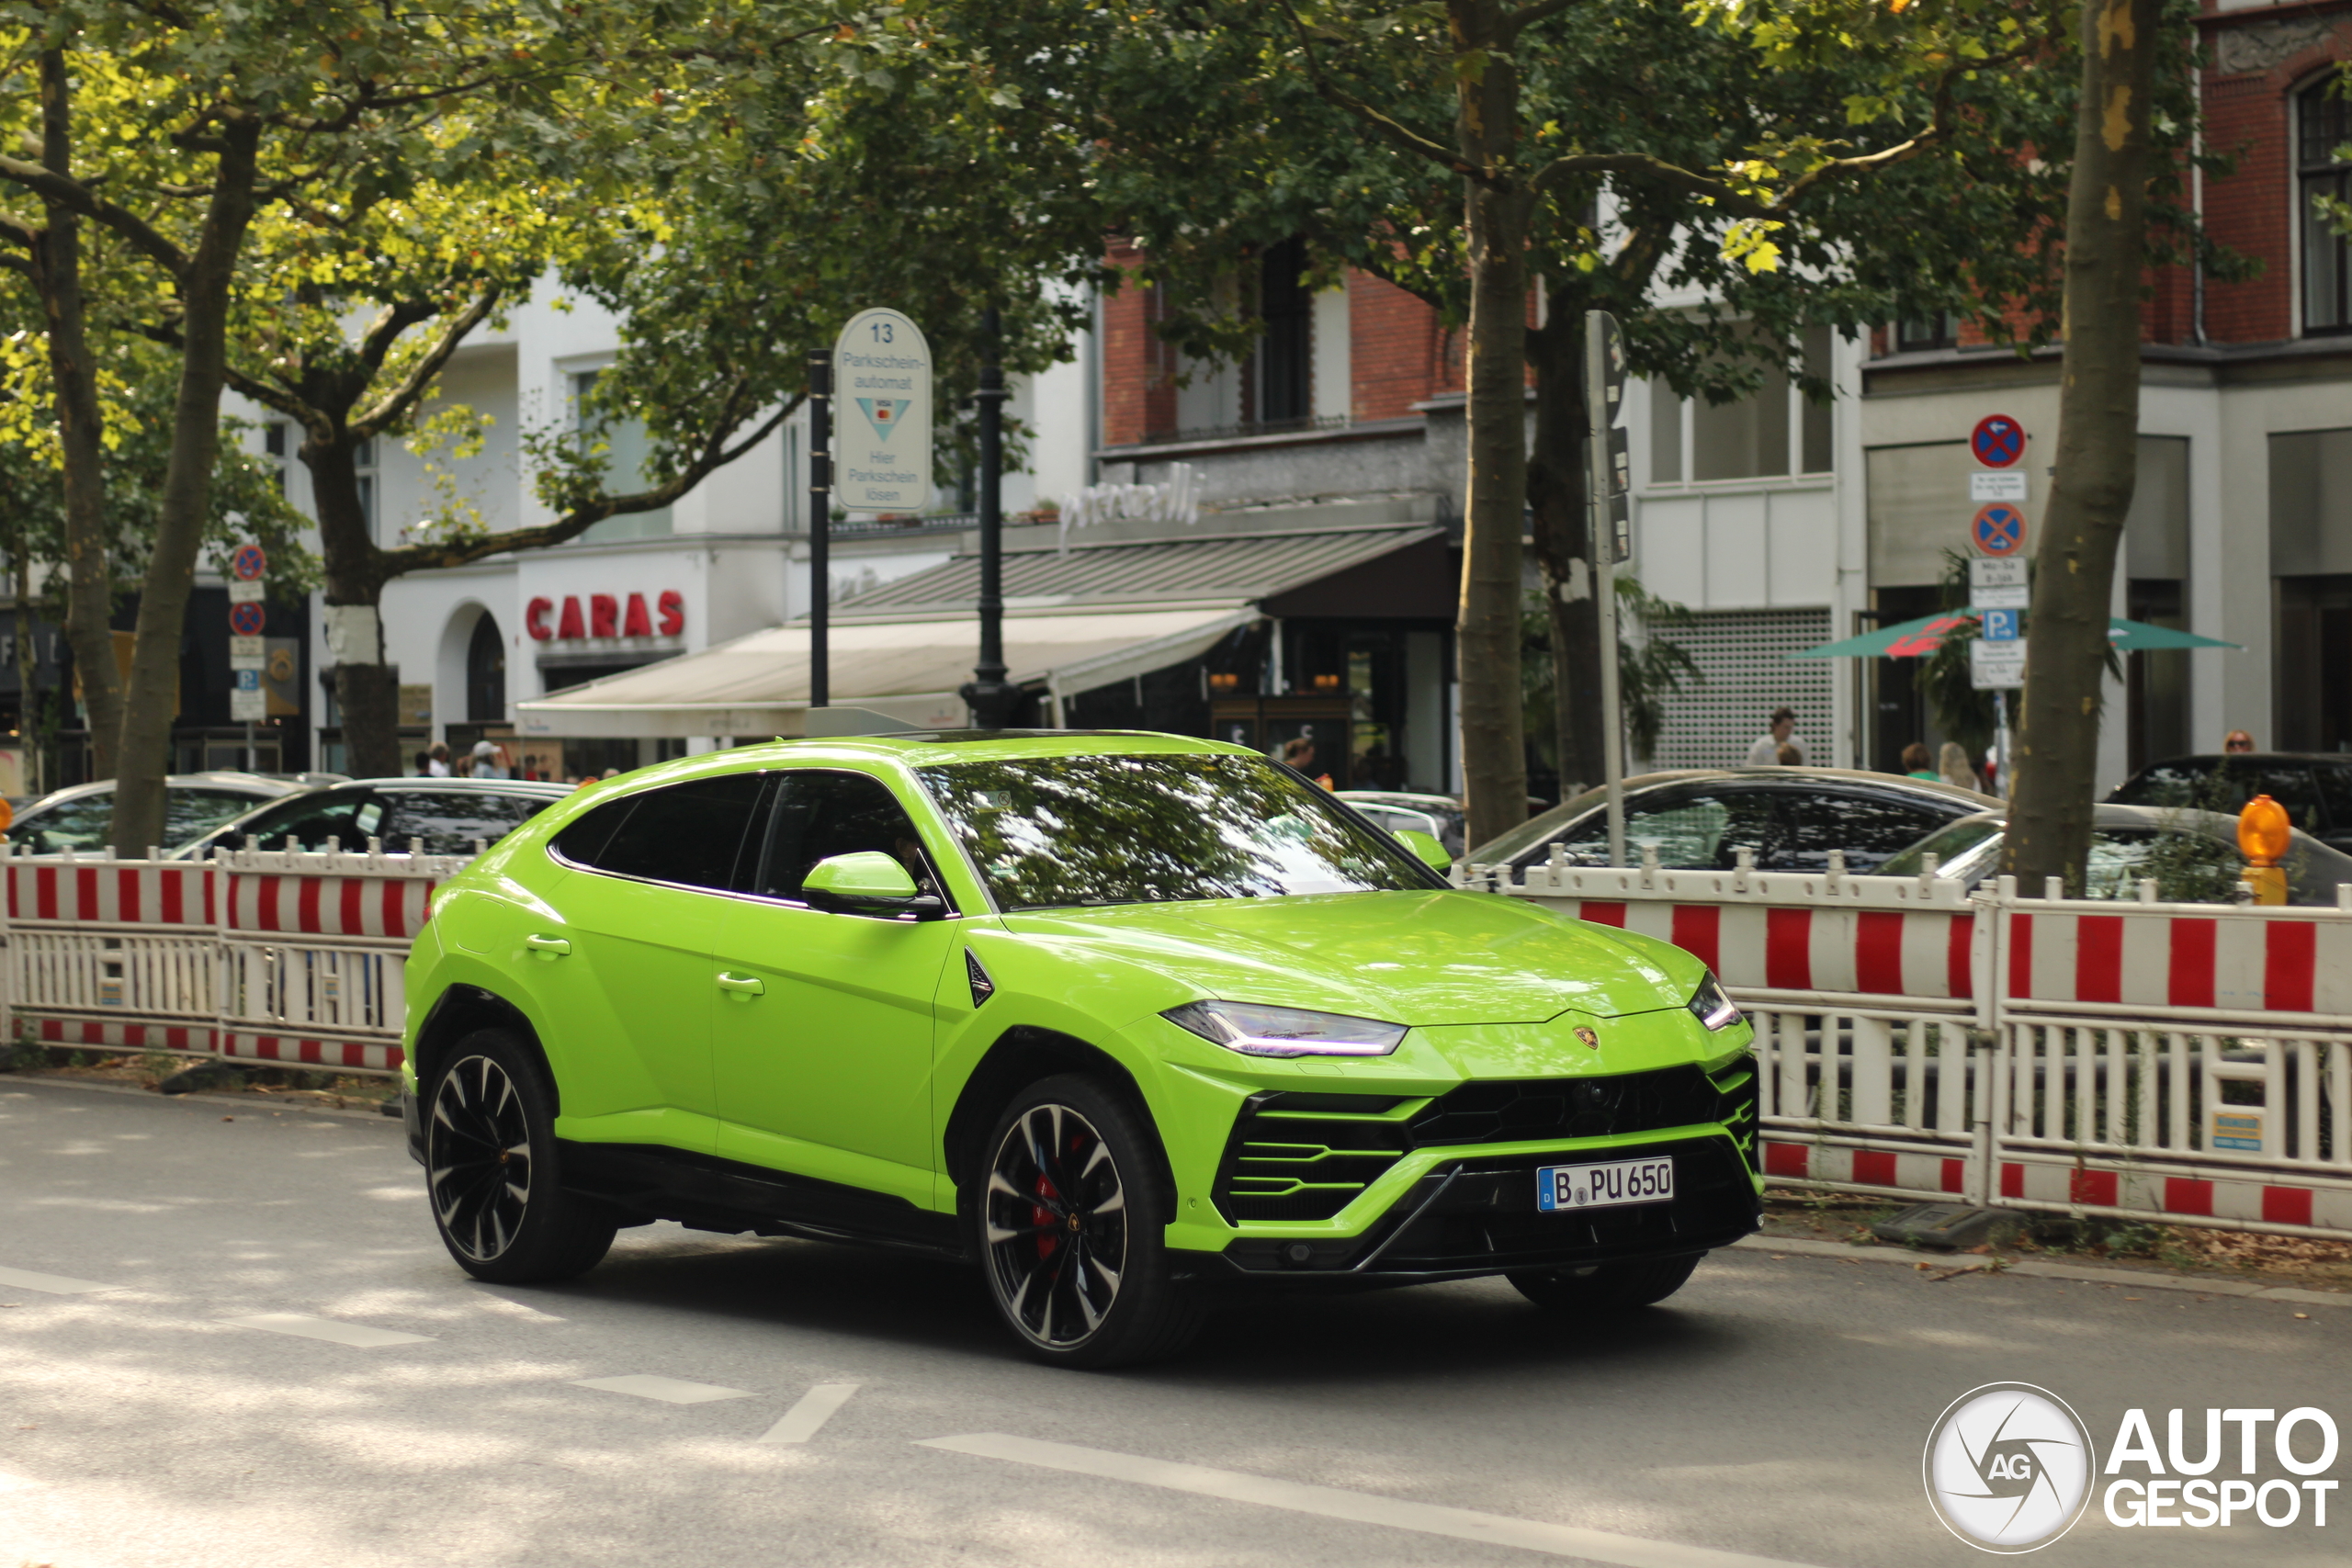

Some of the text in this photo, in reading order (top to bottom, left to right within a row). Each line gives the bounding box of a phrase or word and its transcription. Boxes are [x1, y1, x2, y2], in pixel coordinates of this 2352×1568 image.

[870, 322, 893, 344] 13
[843, 352, 925, 369] Parkschein-
[854, 375, 912, 390] automat
[870, 451, 896, 464] Hier
[848, 468, 918, 483] Parkschein
[865, 488, 900, 501] lösen
[526, 590, 684, 640] CARAS
[1989, 611, 2008, 637] P
[1555, 1172, 1572, 1203] B
[1544, 1193, 1551, 1203] D
